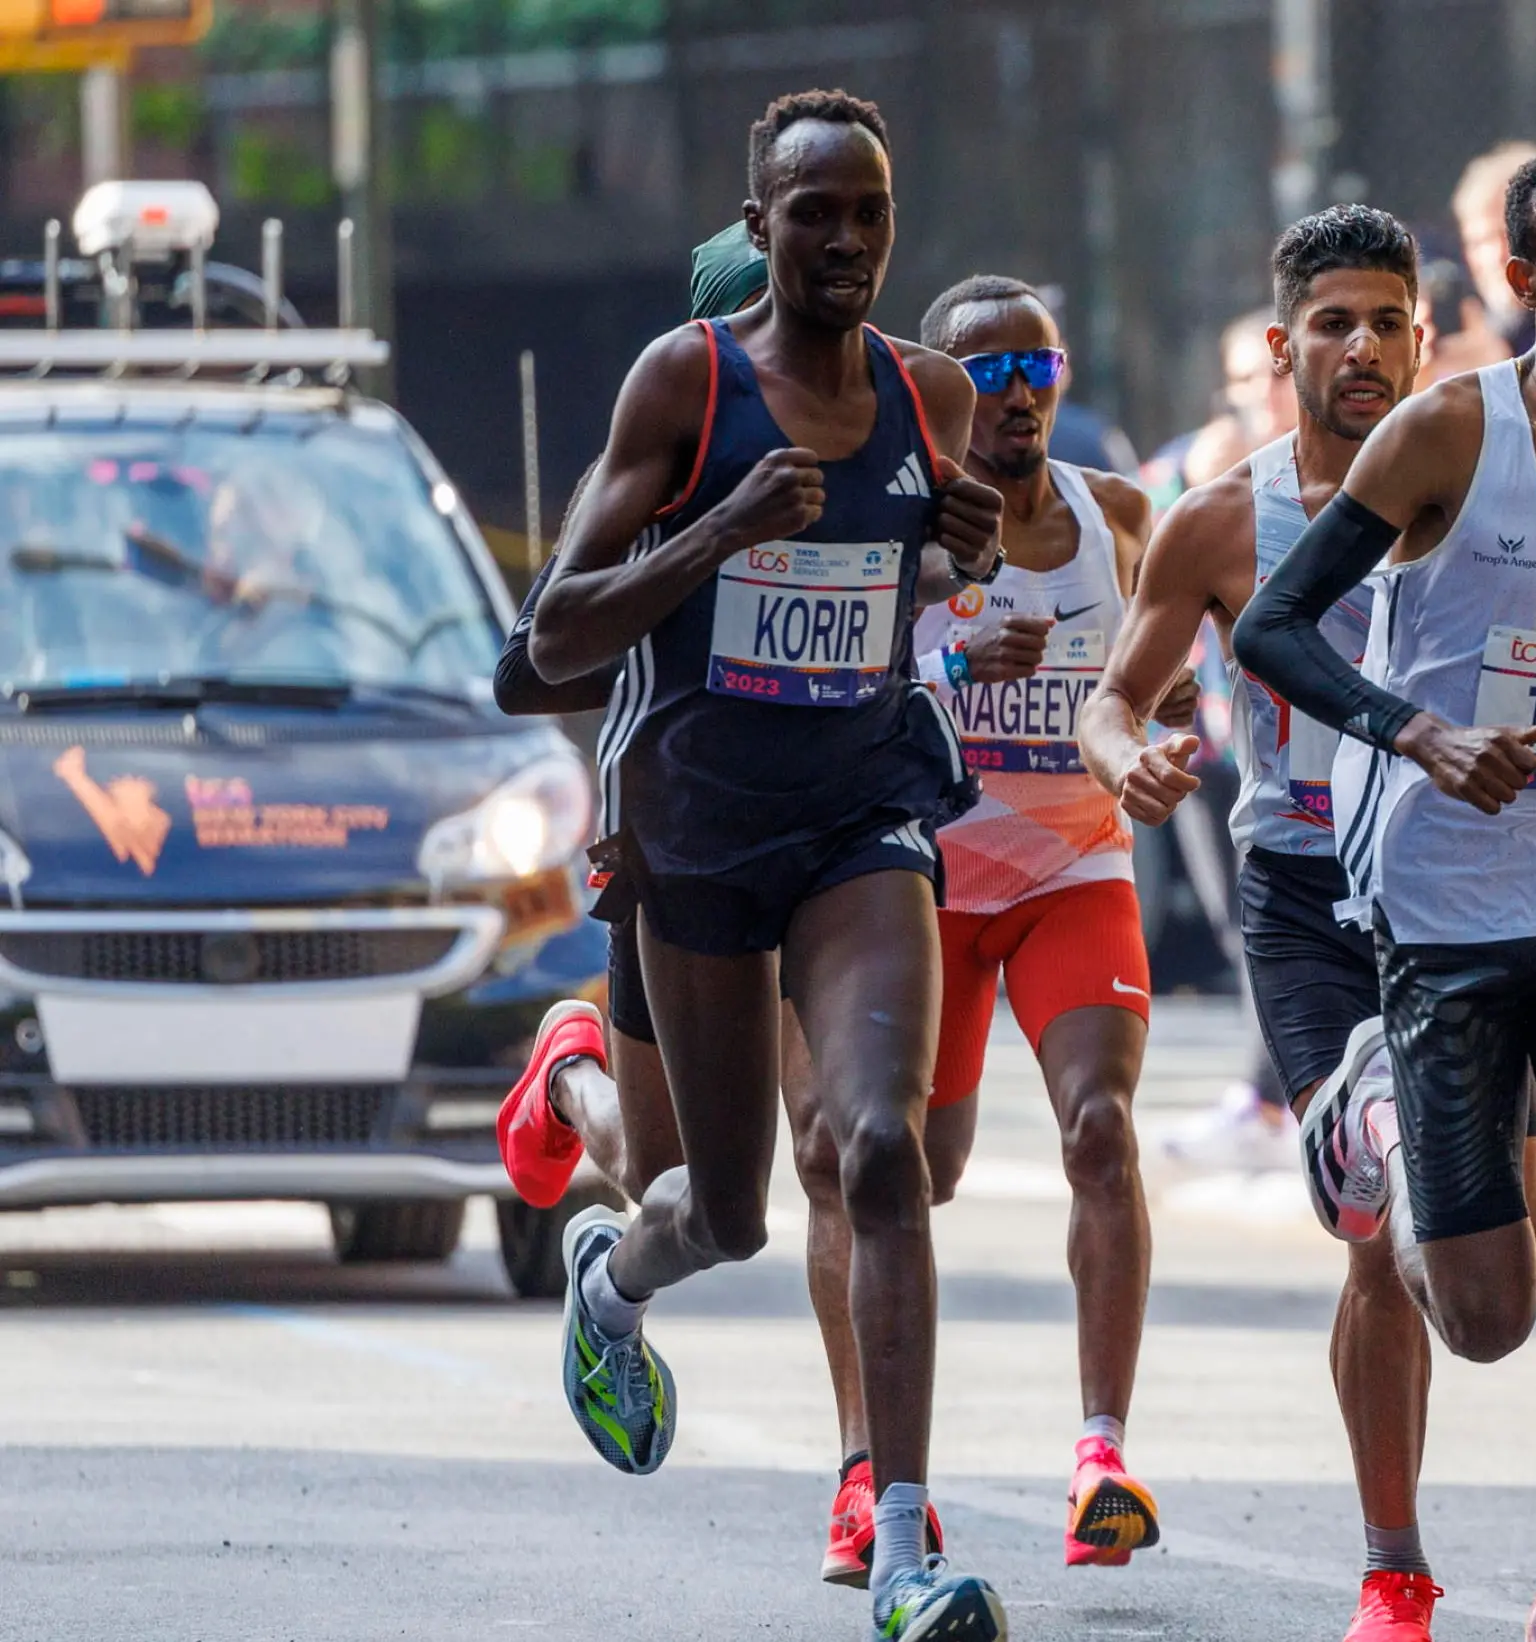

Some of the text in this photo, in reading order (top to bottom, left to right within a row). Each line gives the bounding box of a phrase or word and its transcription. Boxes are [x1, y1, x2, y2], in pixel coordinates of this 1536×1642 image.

[795, 549, 820, 558] TATA
[1472, 551, 1508, 566] Tirop's
[861, 568, 883, 577] TATA
[990, 595, 1014, 611] NN
[754, 594, 870, 663] KORIR
[1066, 651, 1089, 659] TATA
[725, 671, 780, 695] 2023
[962, 750, 1004, 767] 023
[1303, 795, 1330, 811] 20
